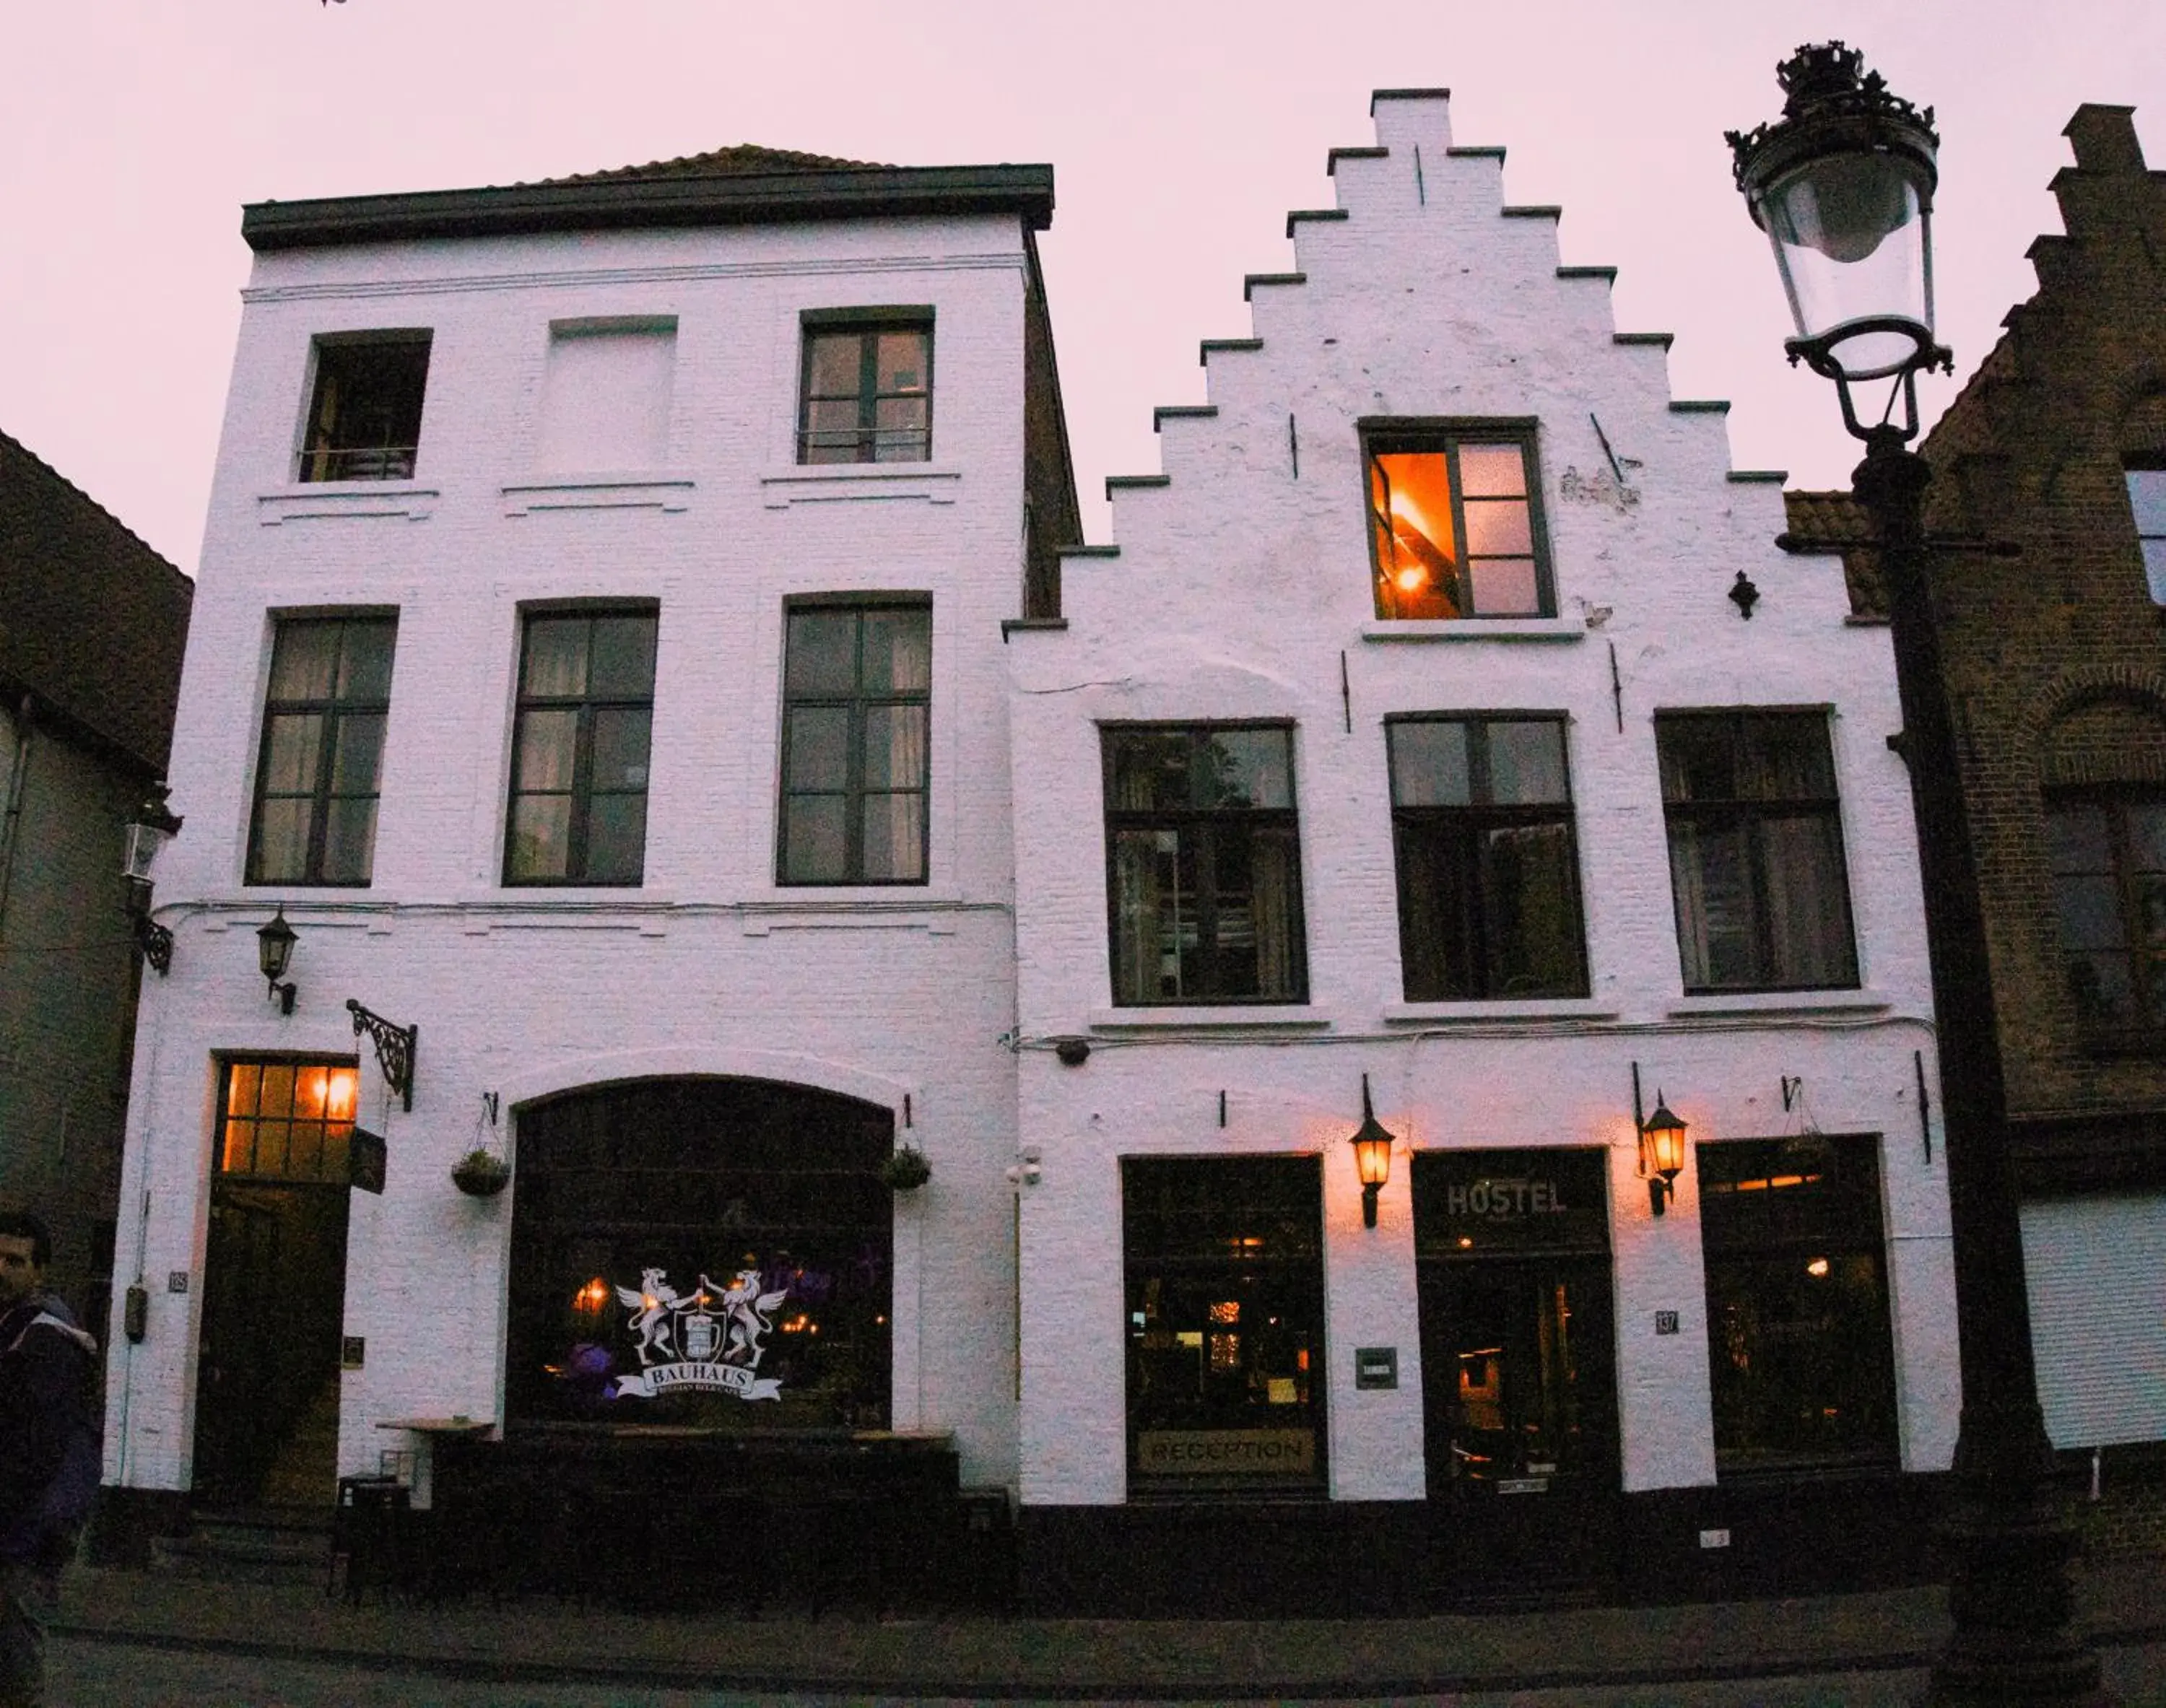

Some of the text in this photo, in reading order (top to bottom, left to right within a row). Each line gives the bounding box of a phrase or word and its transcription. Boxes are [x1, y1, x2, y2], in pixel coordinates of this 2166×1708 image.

[1448, 1180, 1567, 1215] HOSTEL
[651, 1364, 747, 1387] BAUHAUS
[1153, 1442, 1302, 1460] RECEPTION
